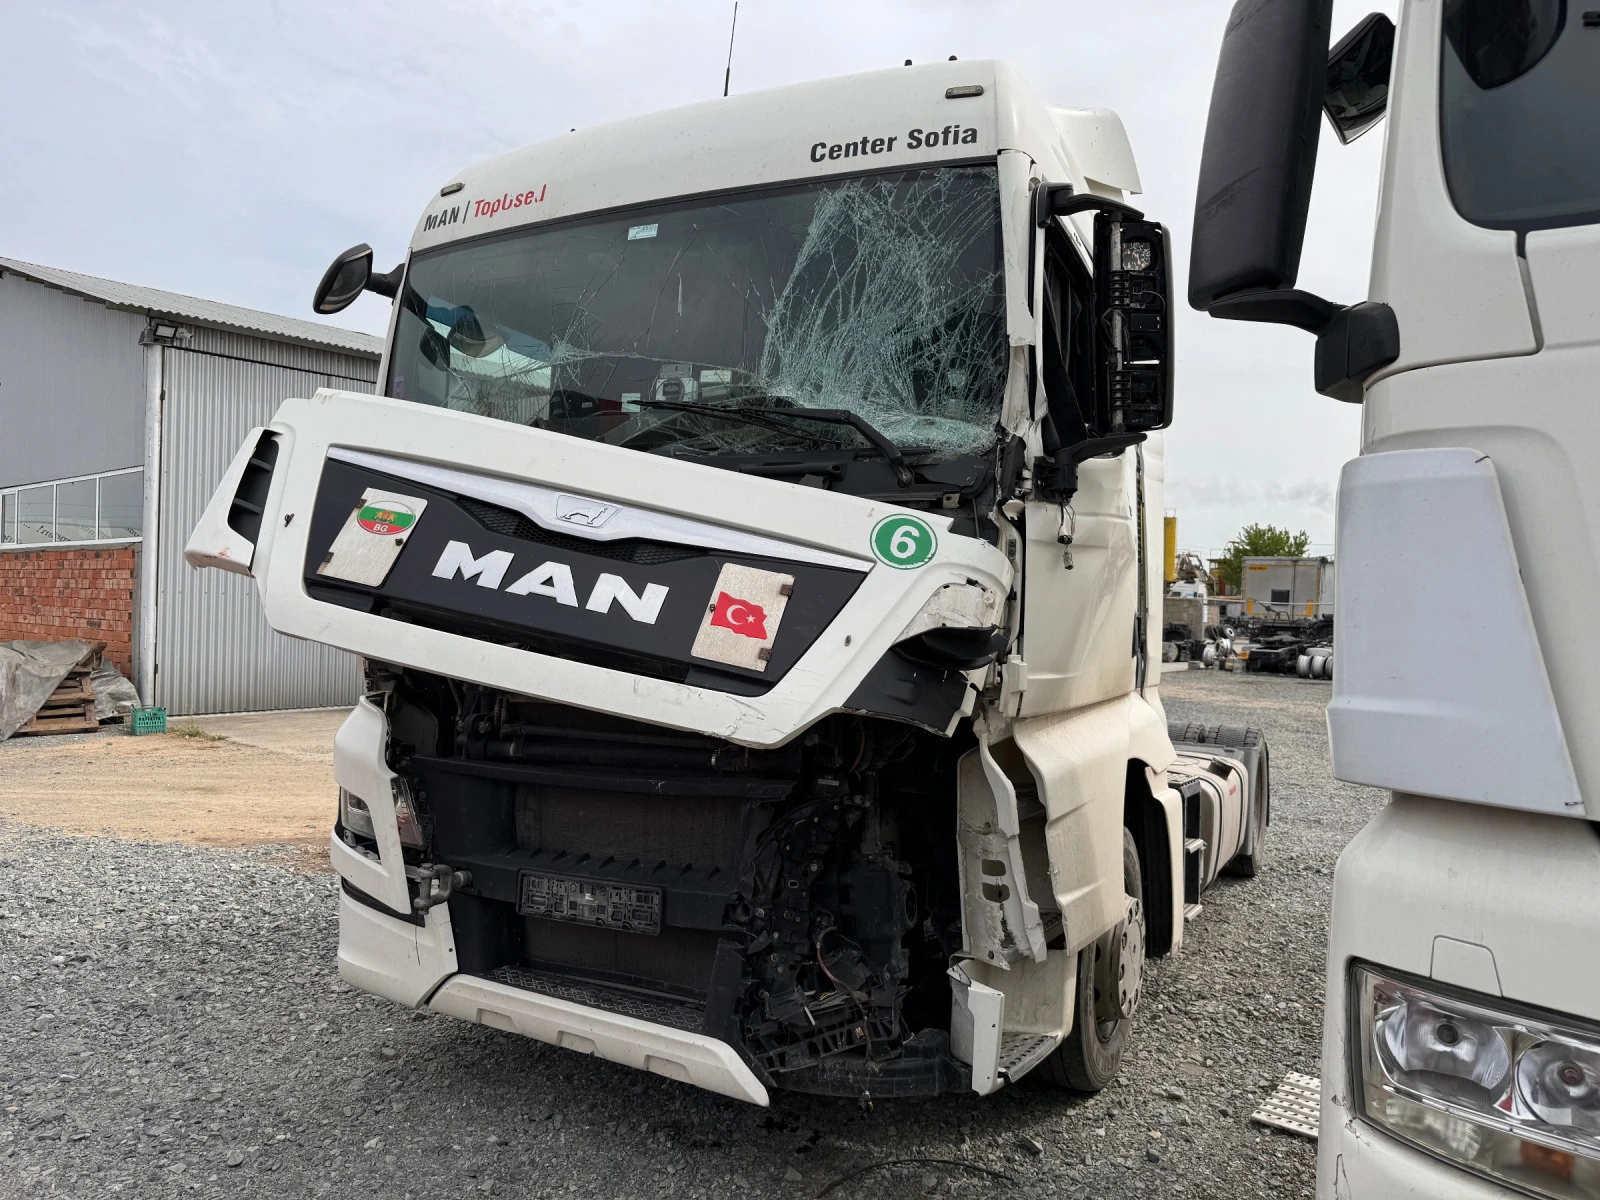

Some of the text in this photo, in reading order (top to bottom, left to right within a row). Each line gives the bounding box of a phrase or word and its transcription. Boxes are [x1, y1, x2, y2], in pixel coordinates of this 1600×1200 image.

[810, 124, 978, 163] Center Sofia
[423, 205, 461, 232] MAN
[373, 523, 389, 533] BG
[889, 525, 920, 559] 6
[431, 539, 670, 625] MAN
